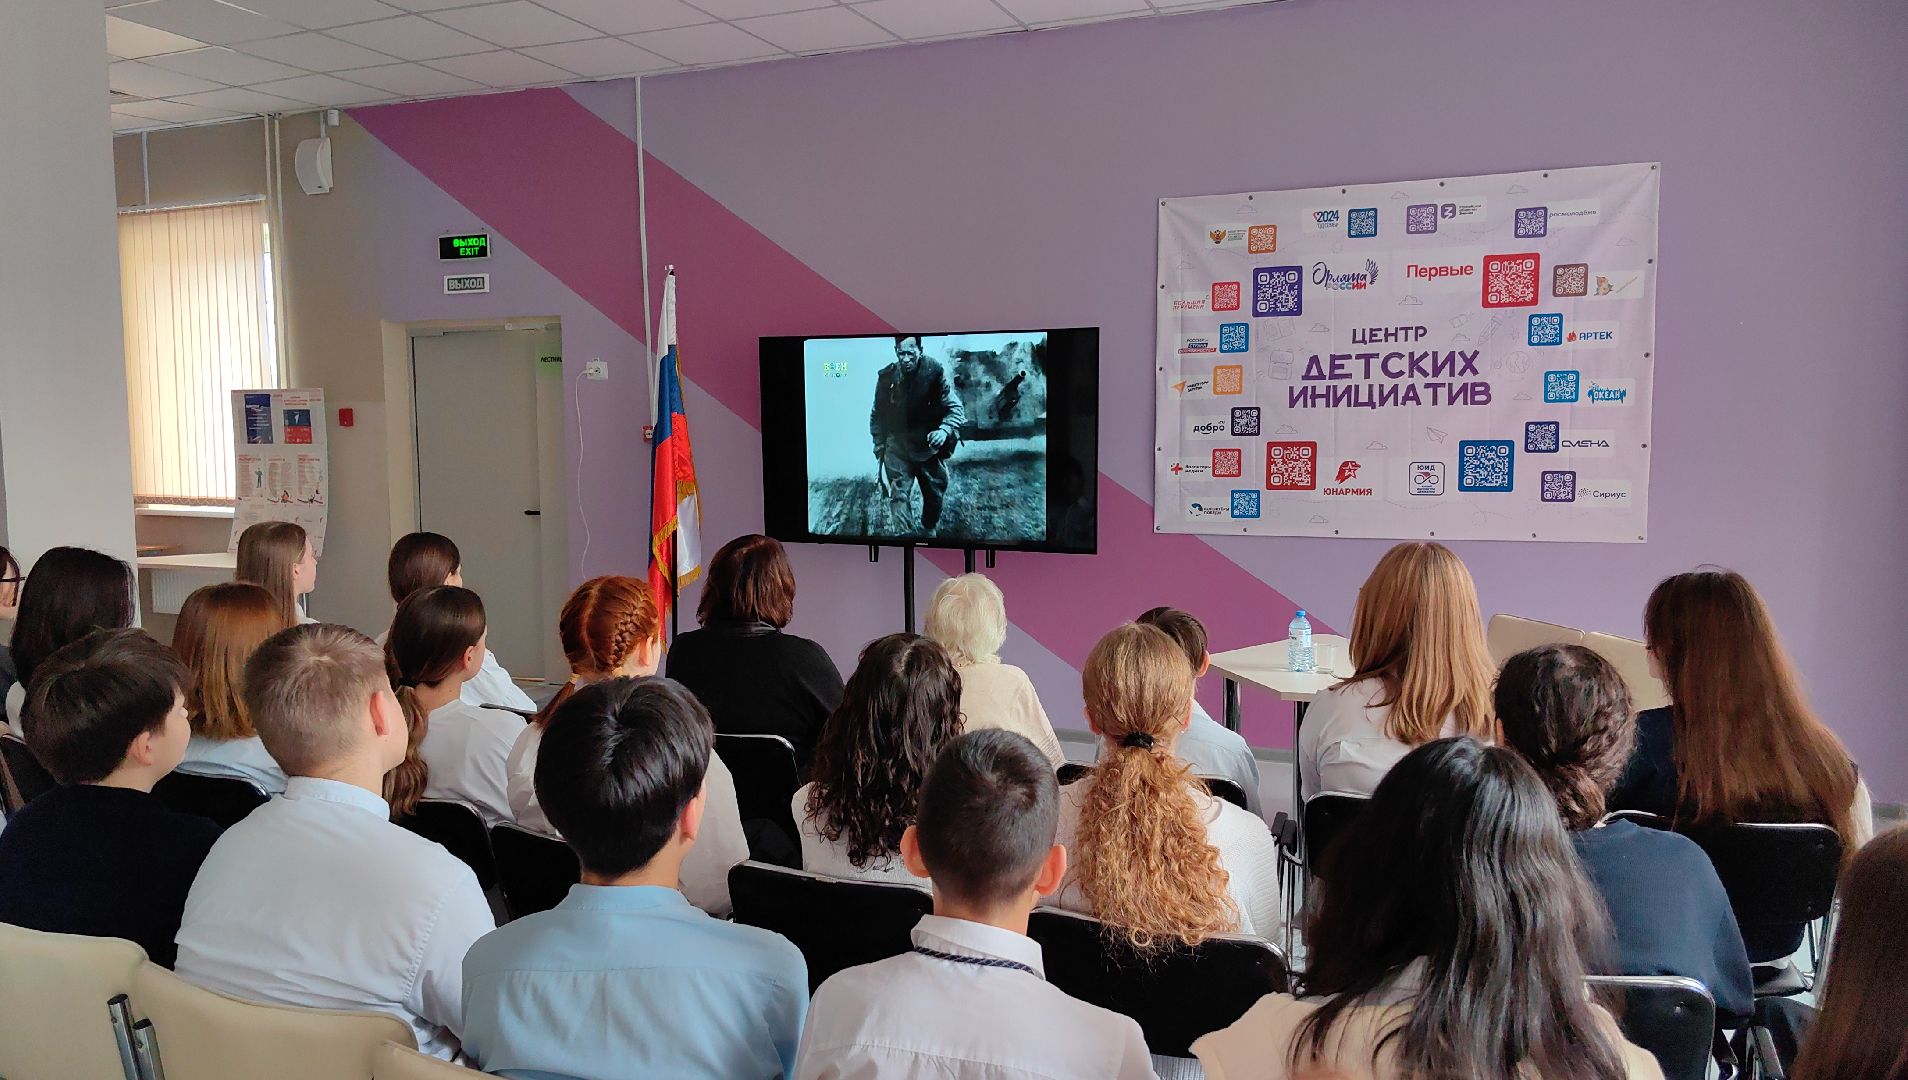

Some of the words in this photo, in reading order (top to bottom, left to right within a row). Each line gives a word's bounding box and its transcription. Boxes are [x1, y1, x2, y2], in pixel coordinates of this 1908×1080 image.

[1317, 210, 1340, 223] 2024
[453, 237, 487, 247] ВЫХОД
[459, 247, 480, 256] EXIT
[1312, 261, 1368, 287] Орлята
[1406, 263, 1474, 281] Первые
[448, 277, 484, 290] ВЫХОД
[1325, 282, 1367, 290] РОССИИ
[1351, 326, 1428, 345] ЦЕНТР
[1579, 331, 1613, 341] АРТЕК
[1301, 350, 1480, 381] ДЕТСКИХ
[1288, 382, 1492, 410] ИНИЦИАТИВ
[1593, 390, 1621, 399] ОКЕАН
[1193, 422, 1225, 434] добро
[1417, 464, 1436, 472] ЮИД
[1323, 487, 1373, 497] ЮНАРМИЯ
[1592, 490, 1627, 500] Сириус
